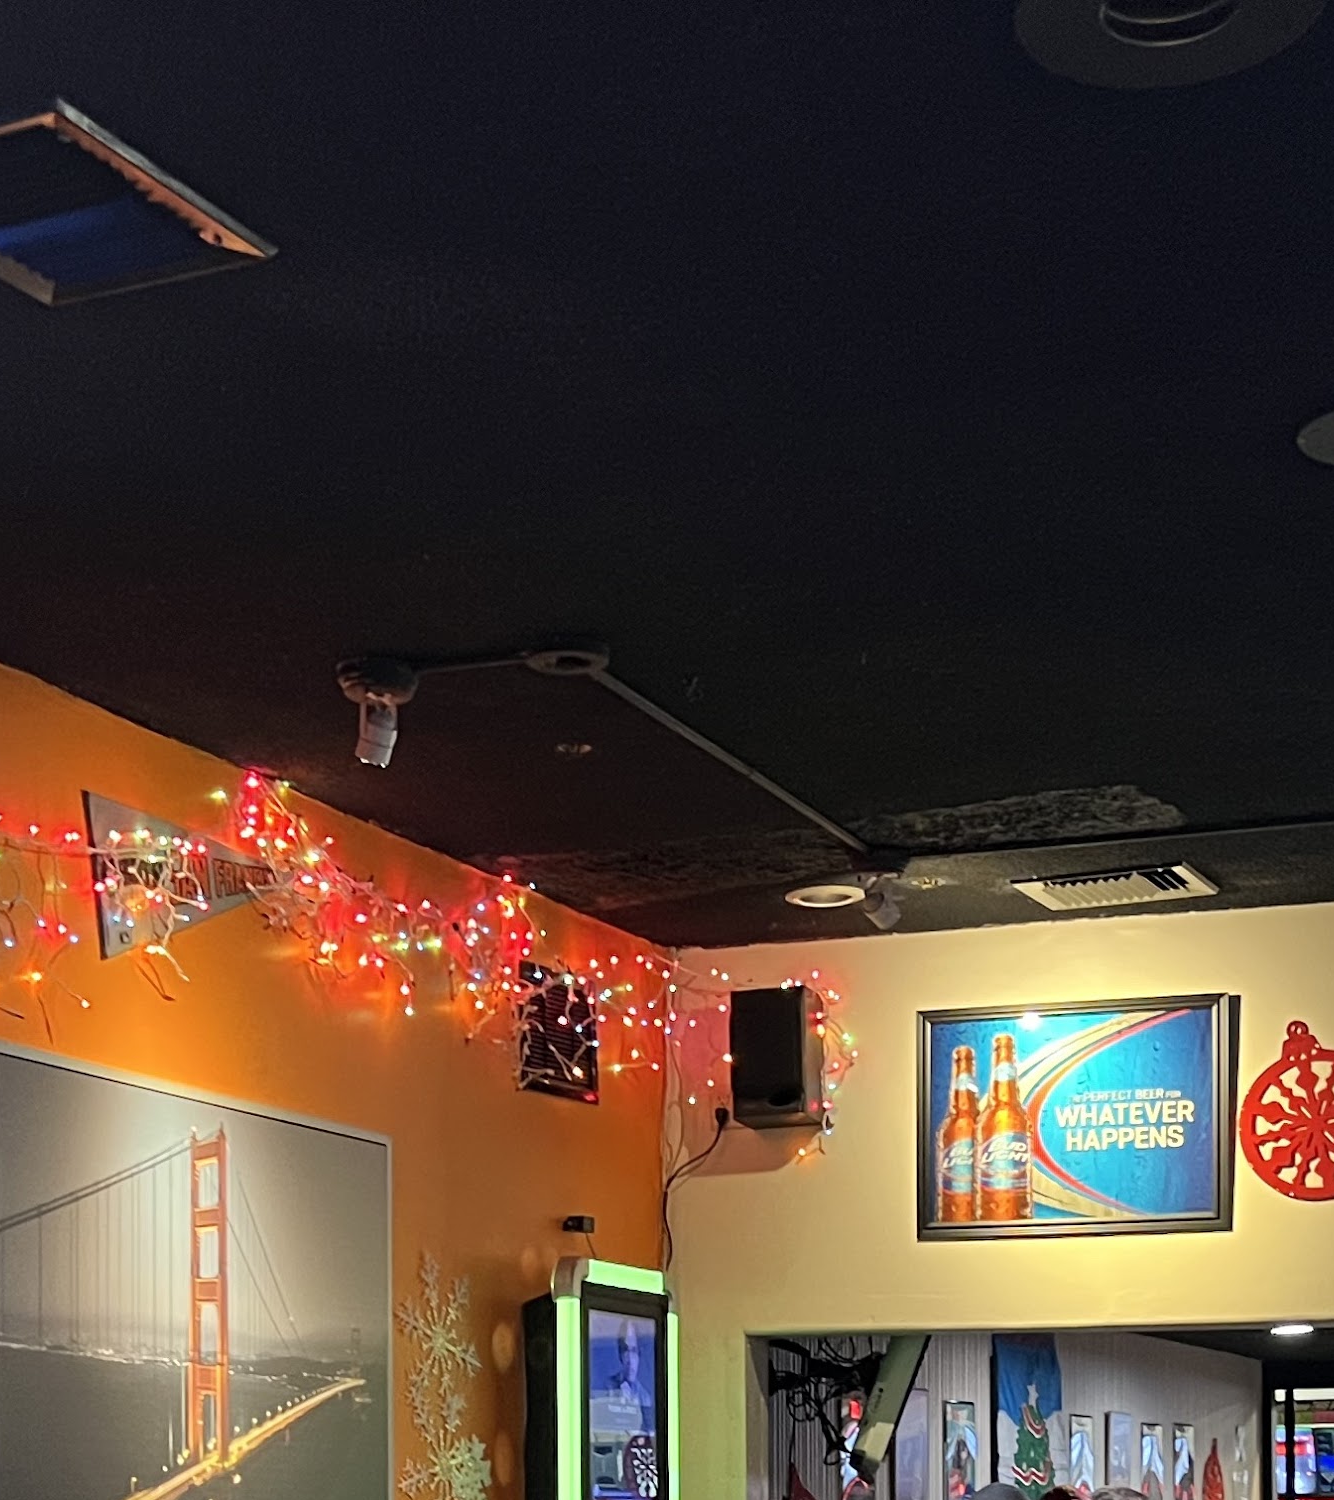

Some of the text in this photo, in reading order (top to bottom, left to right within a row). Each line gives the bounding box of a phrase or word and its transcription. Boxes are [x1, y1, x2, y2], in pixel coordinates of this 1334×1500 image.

[1082, 1090, 1133, 1103] PERFECT
[1134, 1087, 1165, 1100] BEER
[1054, 1100, 1196, 1129] WHATEVER
[987, 1136, 1028, 1153] BUD
[1065, 1125, 1185, 1152] HAPPENS
[980, 1152, 1030, 1165] LIGHT
